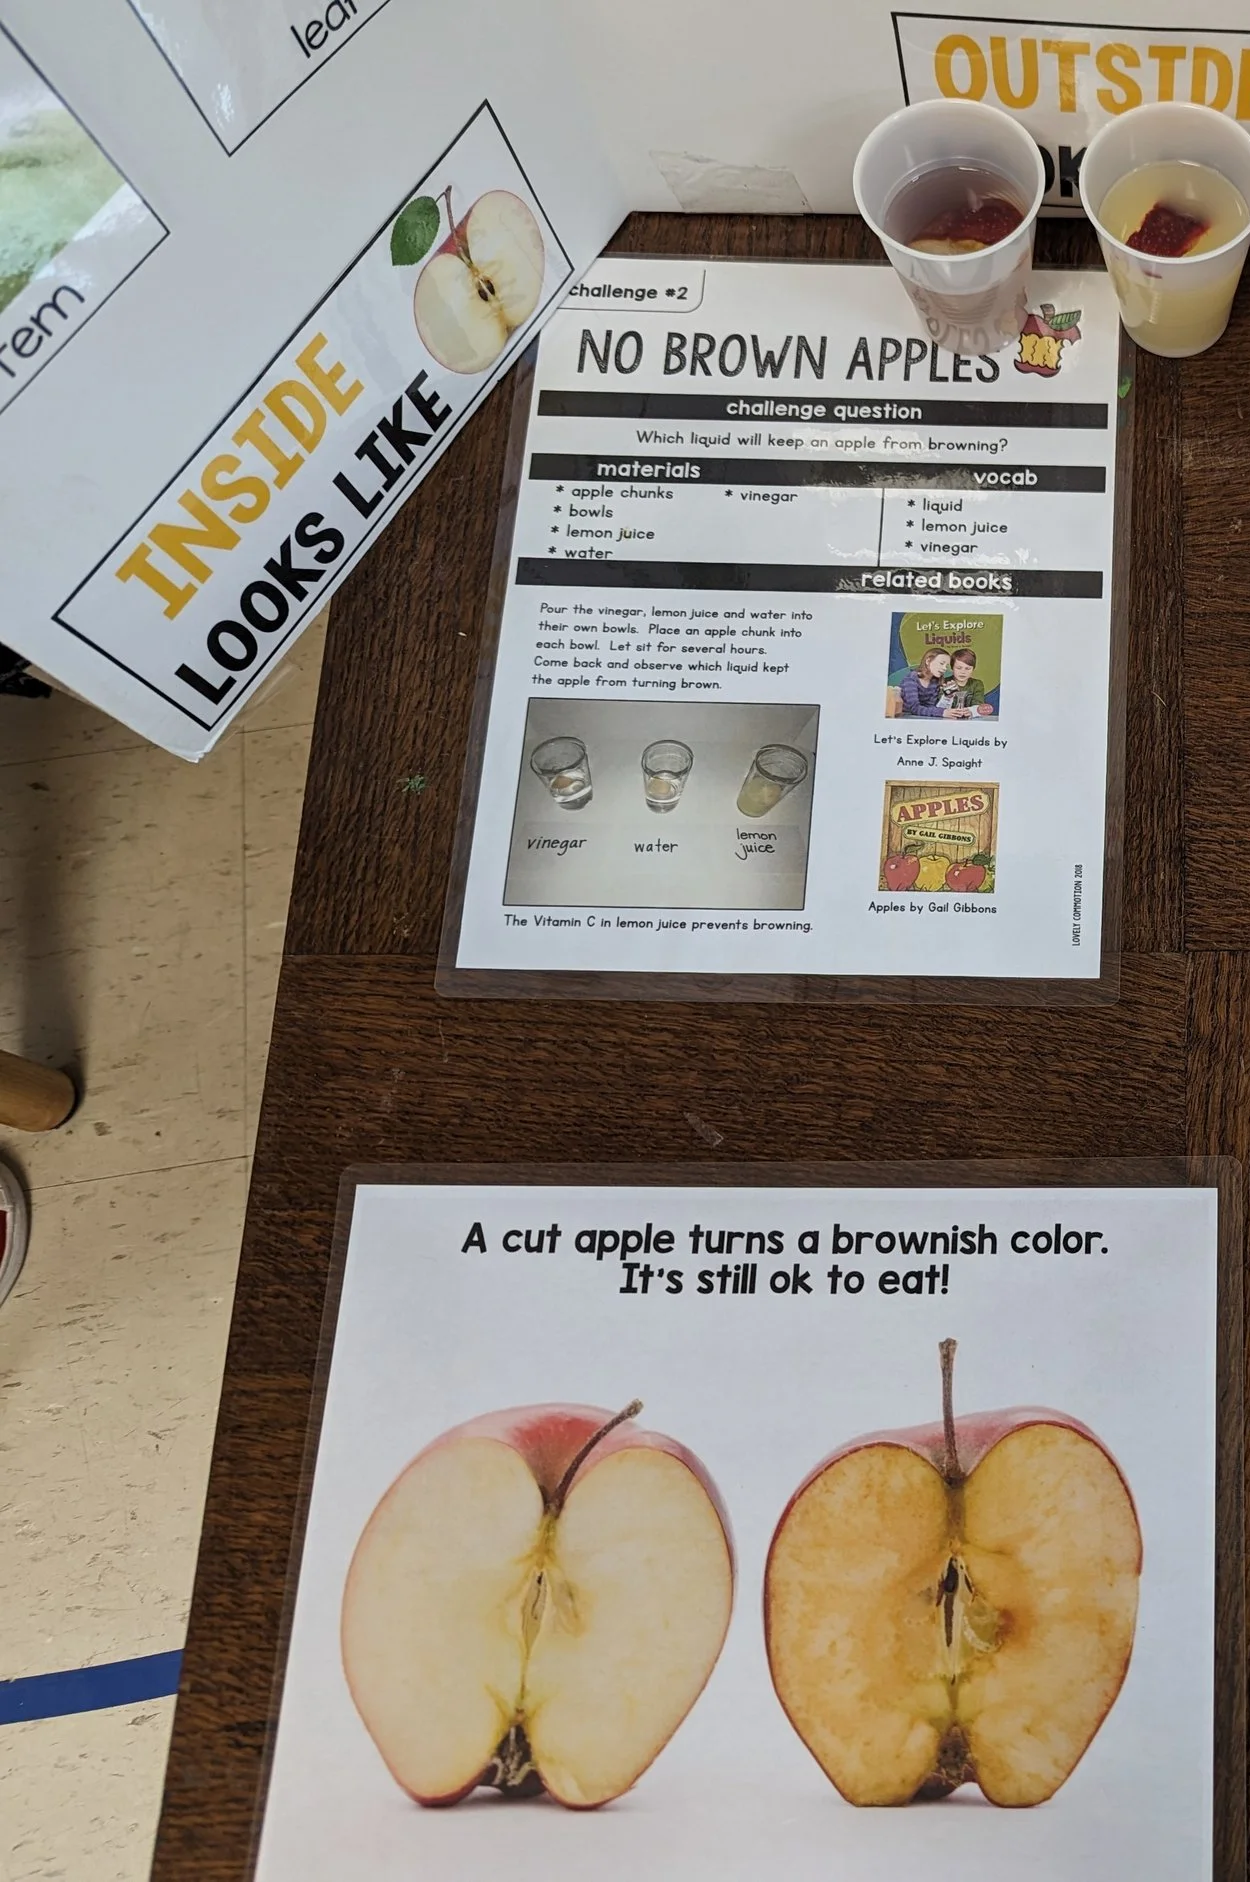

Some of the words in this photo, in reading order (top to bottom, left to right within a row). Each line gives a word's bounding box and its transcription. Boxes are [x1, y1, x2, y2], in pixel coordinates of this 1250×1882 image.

[569, 283, 658, 302] challenge
[666, 286, 688, 300] #2
[576, 329, 644, 376] NO
[663, 333, 828, 380] BROWN
[846, 337, 1000, 384] APPLES
[727, 399, 826, 420] challenge
[834, 403, 921, 421] question
[637, 430, 683, 444] Which
[691, 432, 730, 448] liquid
[738, 433, 761, 446] will
[768, 433, 804, 450] keep
[811, 439, 828, 447] an
[835, 435, 875, 452] apple
[883, 436, 921, 449] from
[929, 436, 1008, 455] browning?
[115, 332, 365, 621] INSIDE
[598, 460, 700, 478] materials
[973, 469, 1039, 486] vocab
[572, 484, 613, 500] apple
[621, 485, 673, 499] chunks
[741, 490, 798, 505] vinegar
[569, 503, 613, 518] bowls
[923, 497, 962, 514] liquid
[567, 524, 612, 539] lemon
[616, 527, 654, 542] juice
[922, 518, 966, 532] lemon
[970, 521, 1007, 536] juice
[174, 512, 345, 705] LOOKS
[332, 369, 453, 520] LIKE
[565, 547, 614, 560] water
[921, 542, 978, 556] vinegar
[860, 571, 942, 591] related
[948, 573, 1014, 592] books
[540, 602, 567, 614] Pour
[573, 604, 593, 614] the
[599, 607, 646, 618] vinegar,
[652, 606, 686, 617] lemon
[689, 609, 718, 621] juice
[724, 608, 745, 619] and
[750, 609, 786, 620] water
[792, 610, 812, 620] into
[916, 621, 941, 631] Let's
[943, 619, 985, 632] Explore
[924, 632, 972, 648] Liquids
[532, 673, 552, 684] the
[558, 675, 590, 688] apple
[596, 675, 626, 687] from
[632, 676, 676, 691] turning
[681, 678, 722, 689] brown.
[874, 733, 902, 744] Let's
[907, 734, 947, 747] Explore
[952, 736, 990, 748] Liquids
[995, 737, 1007, 749] by
[897, 756, 923, 766] Anne
[928, 756, 938, 766] J.
[942, 756, 982, 770] Spaight
[896, 795, 985, 823] APPLES
[736, 828, 778, 842] lemon
[907, 828, 918, 836] BY
[919, 830, 936, 839] GAIL
[527, 836, 587, 856] vinegar
[633, 838, 679, 854] water
[735, 841, 776, 861] juice
[1074, 864, 1083, 878] 2018
[869, 901, 905, 914] Apples
[910, 901, 923, 915] by
[929, 902, 948, 913] Gail
[954, 902, 996, 914] Gibbons
[1073, 881, 1083, 921] COMMOTION
[504, 914, 527, 926] The
[534, 914, 581, 927] Vitamin
[587, 915, 595, 927] C
[601, 918, 611, 927] in
[617, 916, 653, 929] lemon
[656, 919, 686, 931] juice
[692, 919, 748, 932] prevents
[753, 919, 813, 933] browning.
[1072, 922, 1082, 947] LOVELY
[461, 1222, 487, 1254] A
[503, 1224, 561, 1254] cut
[575, 1223, 674, 1261] apple
[689, 1224, 784, 1255] turns
[798, 1230, 819, 1254] a
[832, 1223, 997, 1255] brownish
[1011, 1223, 1108, 1254] color.
[620, 1262, 683, 1294] It's
[697, 1262, 757, 1295] still
[770, 1264, 813, 1295] ok
[827, 1265, 864, 1295] to
[879, 1263, 949, 1295] eat!
